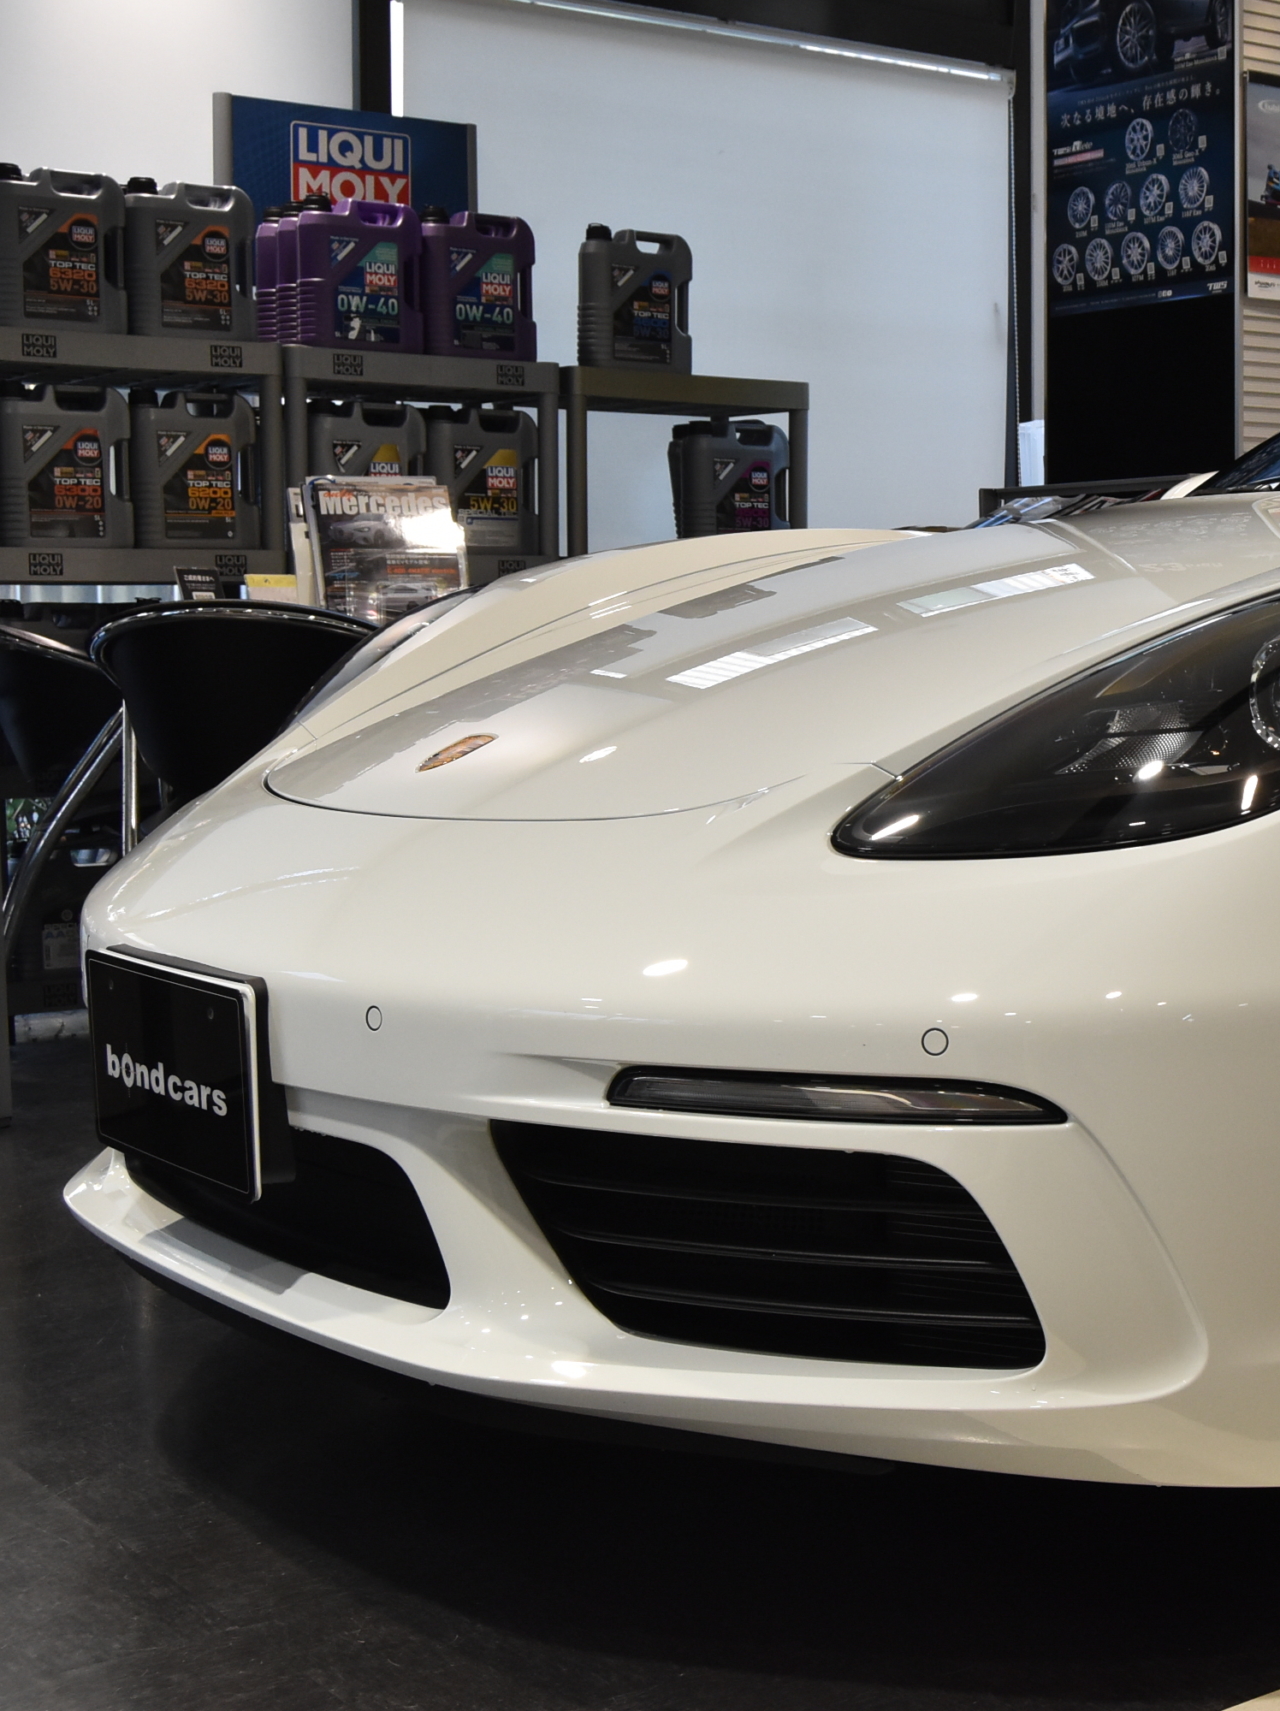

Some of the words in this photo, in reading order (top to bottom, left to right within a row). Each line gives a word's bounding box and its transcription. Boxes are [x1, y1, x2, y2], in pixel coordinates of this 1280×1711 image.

[298, 126, 404, 172] LIQUI
[298, 167, 408, 204] MOLY
[76, 262, 96, 270] TEC
[366, 262, 396, 274] LIQUI
[208, 273, 228, 281] TEC
[366, 274, 397, 286] MOLY
[482, 272, 511, 284] LIQUI
[50, 279, 97, 293] 5W-30
[482, 284, 512, 295] MOLY
[185, 289, 229, 303] 5W-30
[337, 294, 398, 316] 0W-40
[456, 304, 513, 323] 0W-40
[23, 334, 55, 346] LIQUI
[23, 346, 56, 357] MOLY
[212, 346, 241, 357] LIQUI
[212, 357, 242, 367] MOLY
[334, 354, 362, 365] LIQUI
[334, 365, 362, 375] MOLY
[370, 462, 399, 473] LIQUI
[487, 467, 515, 477] LIQUI
[487, 478, 516, 488] MOLY
[188, 487, 231, 498] 6200
[55, 496, 102, 509] 0W-20
[189, 497, 232, 510] 0W-20
[318, 489, 447, 516] Mercedes
[470, 497, 517, 512] 5W-30
[30, 554, 61, 564] LIQUI
[31, 565, 62, 575] MOLY
